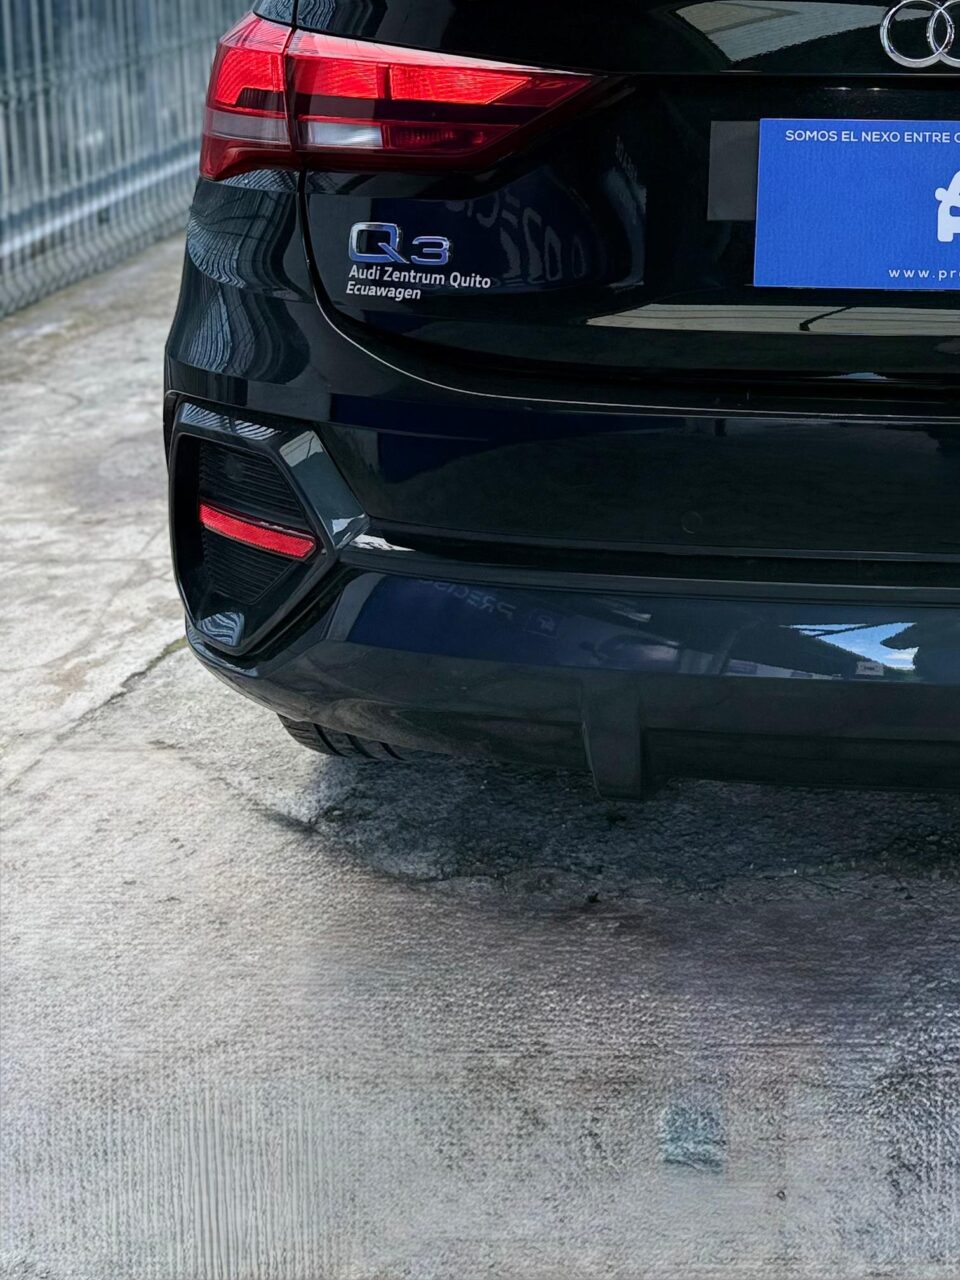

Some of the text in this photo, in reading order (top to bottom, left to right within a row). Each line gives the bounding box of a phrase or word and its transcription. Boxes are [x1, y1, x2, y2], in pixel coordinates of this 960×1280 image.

[785, 130, 838, 142] SOMOS
[841, 131, 858, 142] EL
[861, 131, 900, 143] NEXO
[904, 131, 951, 143] ENTRE
[349, 222, 450, 266] Q3
[349, 265, 491, 288] Audi Zentrum Quito
[346, 281, 421, 301] Ecuawagen
